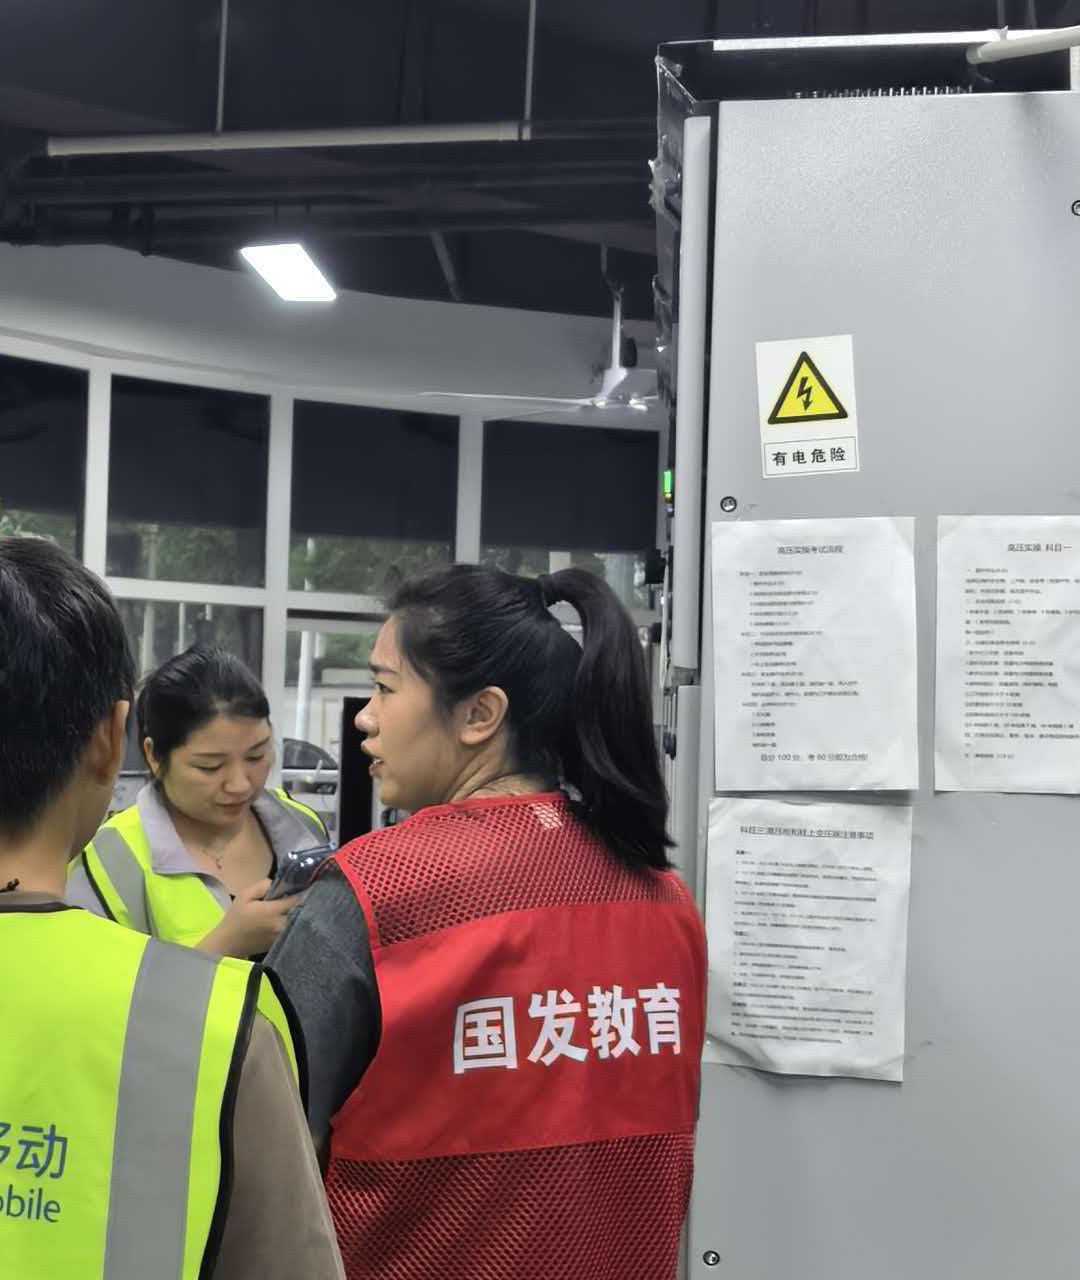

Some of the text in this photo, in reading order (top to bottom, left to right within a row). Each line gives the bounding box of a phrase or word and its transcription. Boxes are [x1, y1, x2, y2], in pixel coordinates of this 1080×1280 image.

[771, 447, 847, 467] 有电危险
[453, 982, 680, 1074] 国发教育
